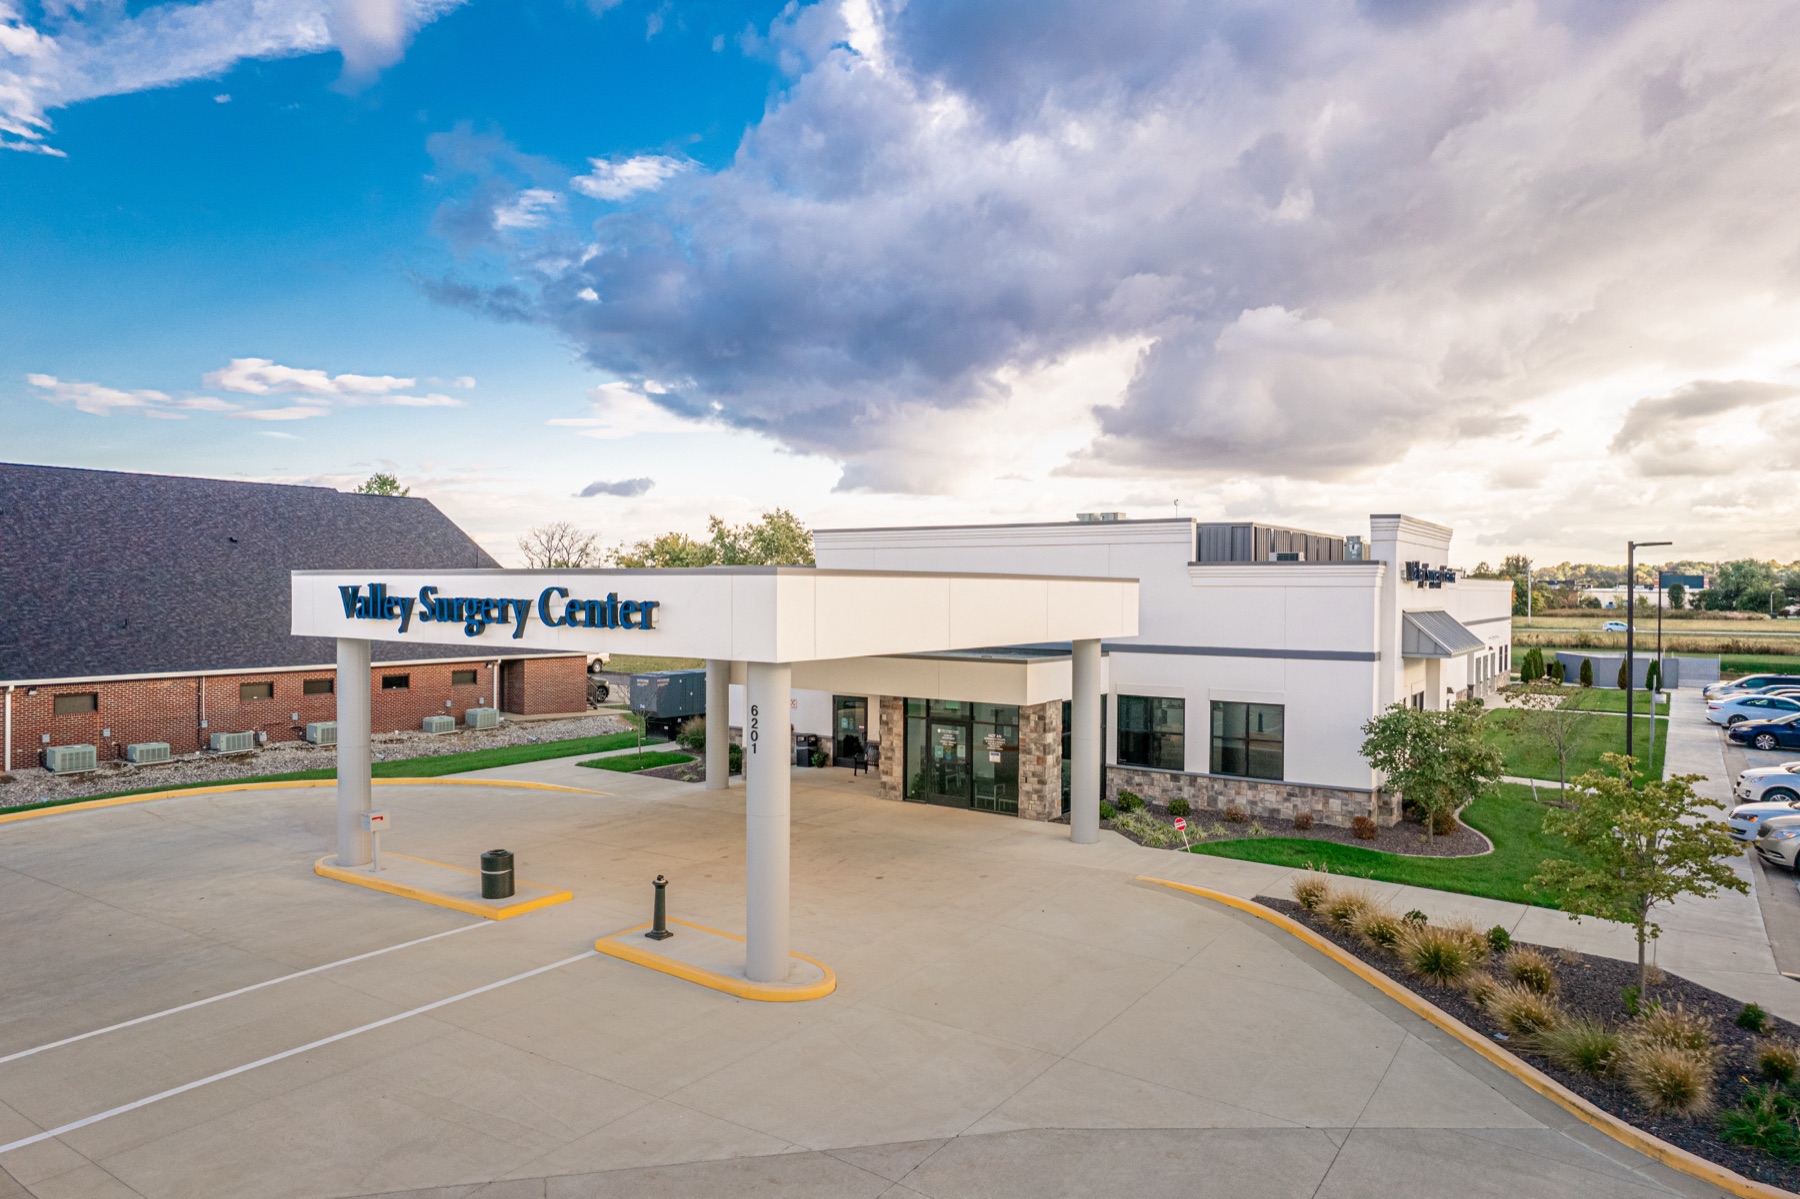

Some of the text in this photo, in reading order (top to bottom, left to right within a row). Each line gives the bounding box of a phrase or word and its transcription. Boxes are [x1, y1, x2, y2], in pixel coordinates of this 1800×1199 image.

[338, 583, 660, 640] Valley Surgery Center
[750, 704, 759, 754] 6201
